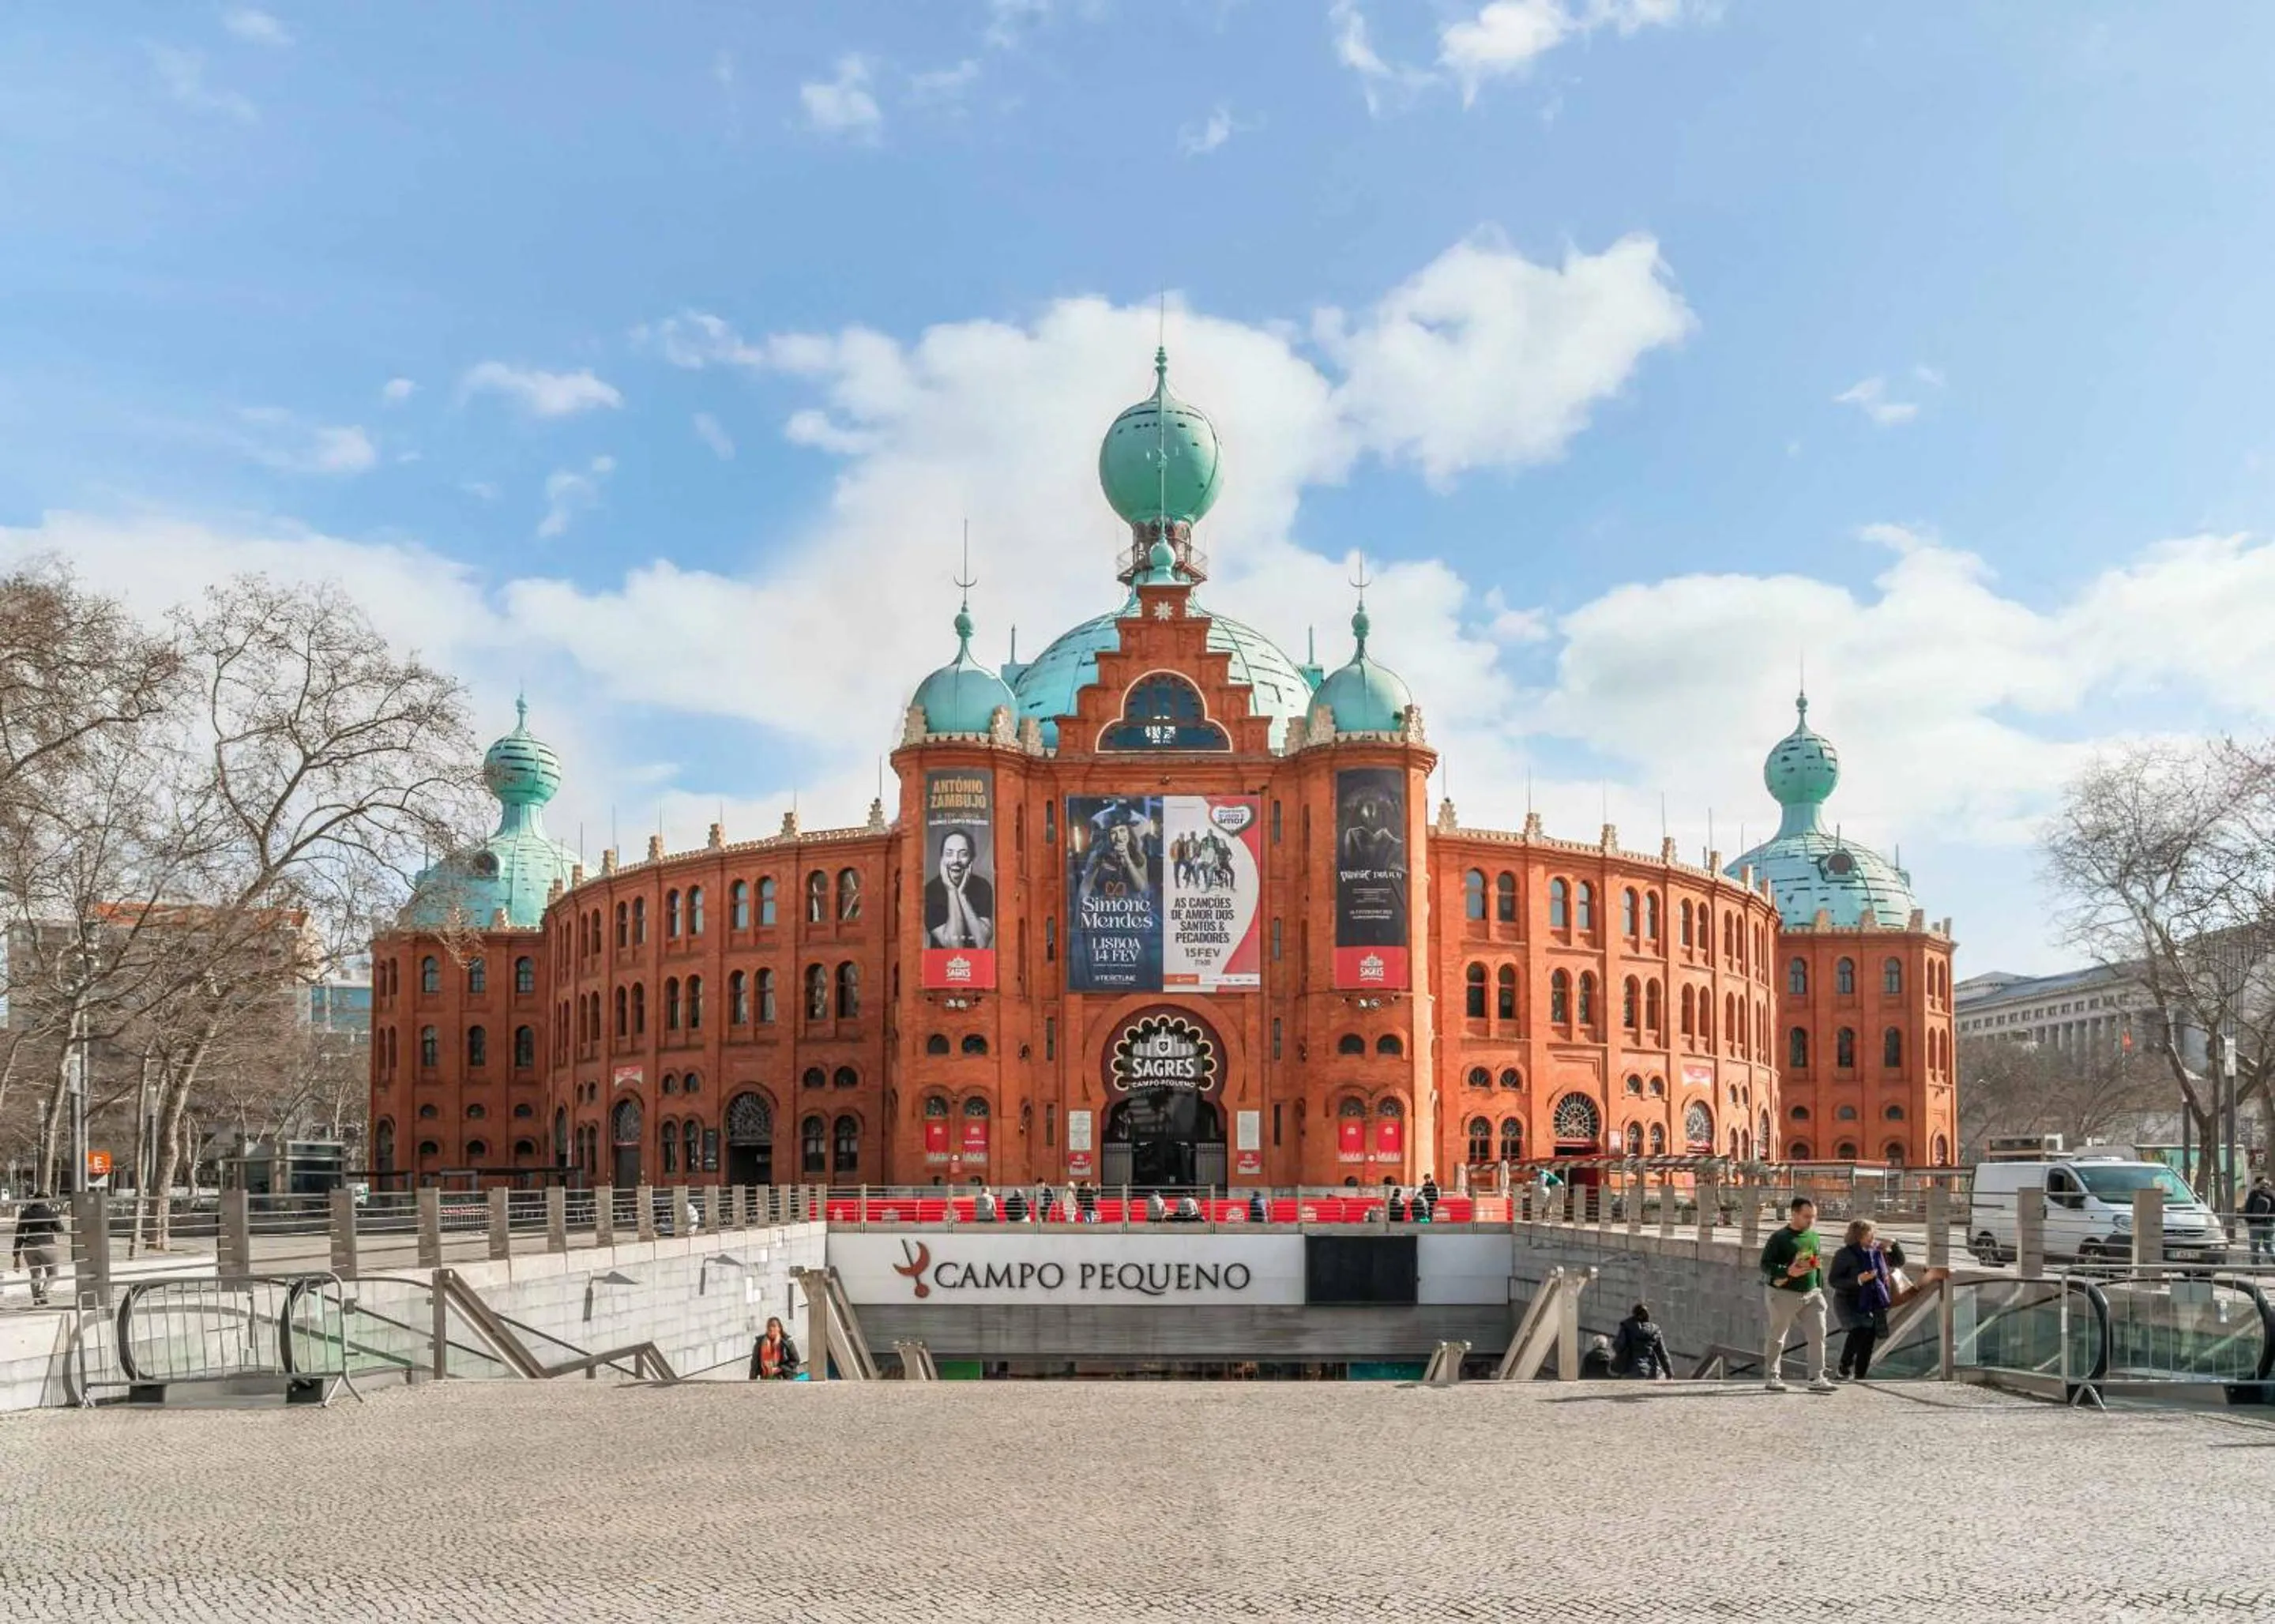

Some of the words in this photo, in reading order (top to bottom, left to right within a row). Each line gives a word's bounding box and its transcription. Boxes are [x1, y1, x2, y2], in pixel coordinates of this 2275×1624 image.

[933, 776, 983, 793] ANTÓNIO
[930, 794, 987, 808] ZAMBUJO
[1081, 897, 1151, 912] Simone
[1174, 897, 1186, 908] AS
[1081, 912, 1153, 928] Mendes
[1171, 909, 1183, 920] DE
[1185, 909, 1213, 920] AMOR
[1216, 909, 1235, 920] DOS
[1180, 921, 1216, 931] SANTOS
[1218, 922, 1225, 931] &
[1092, 937, 1141, 949] LISBOA
[1175, 932, 1230, 944] PECADORES
[1095, 949, 1108, 961] 14
[1111, 949, 1140, 962] FEV
[1132, 1058, 1195, 1079] SAGRES
[1132, 1079, 1160, 1088] CAMPO
[933, 1261, 1064, 1290] CAMPO
[1079, 1261, 1250, 1296] PEQUENO
